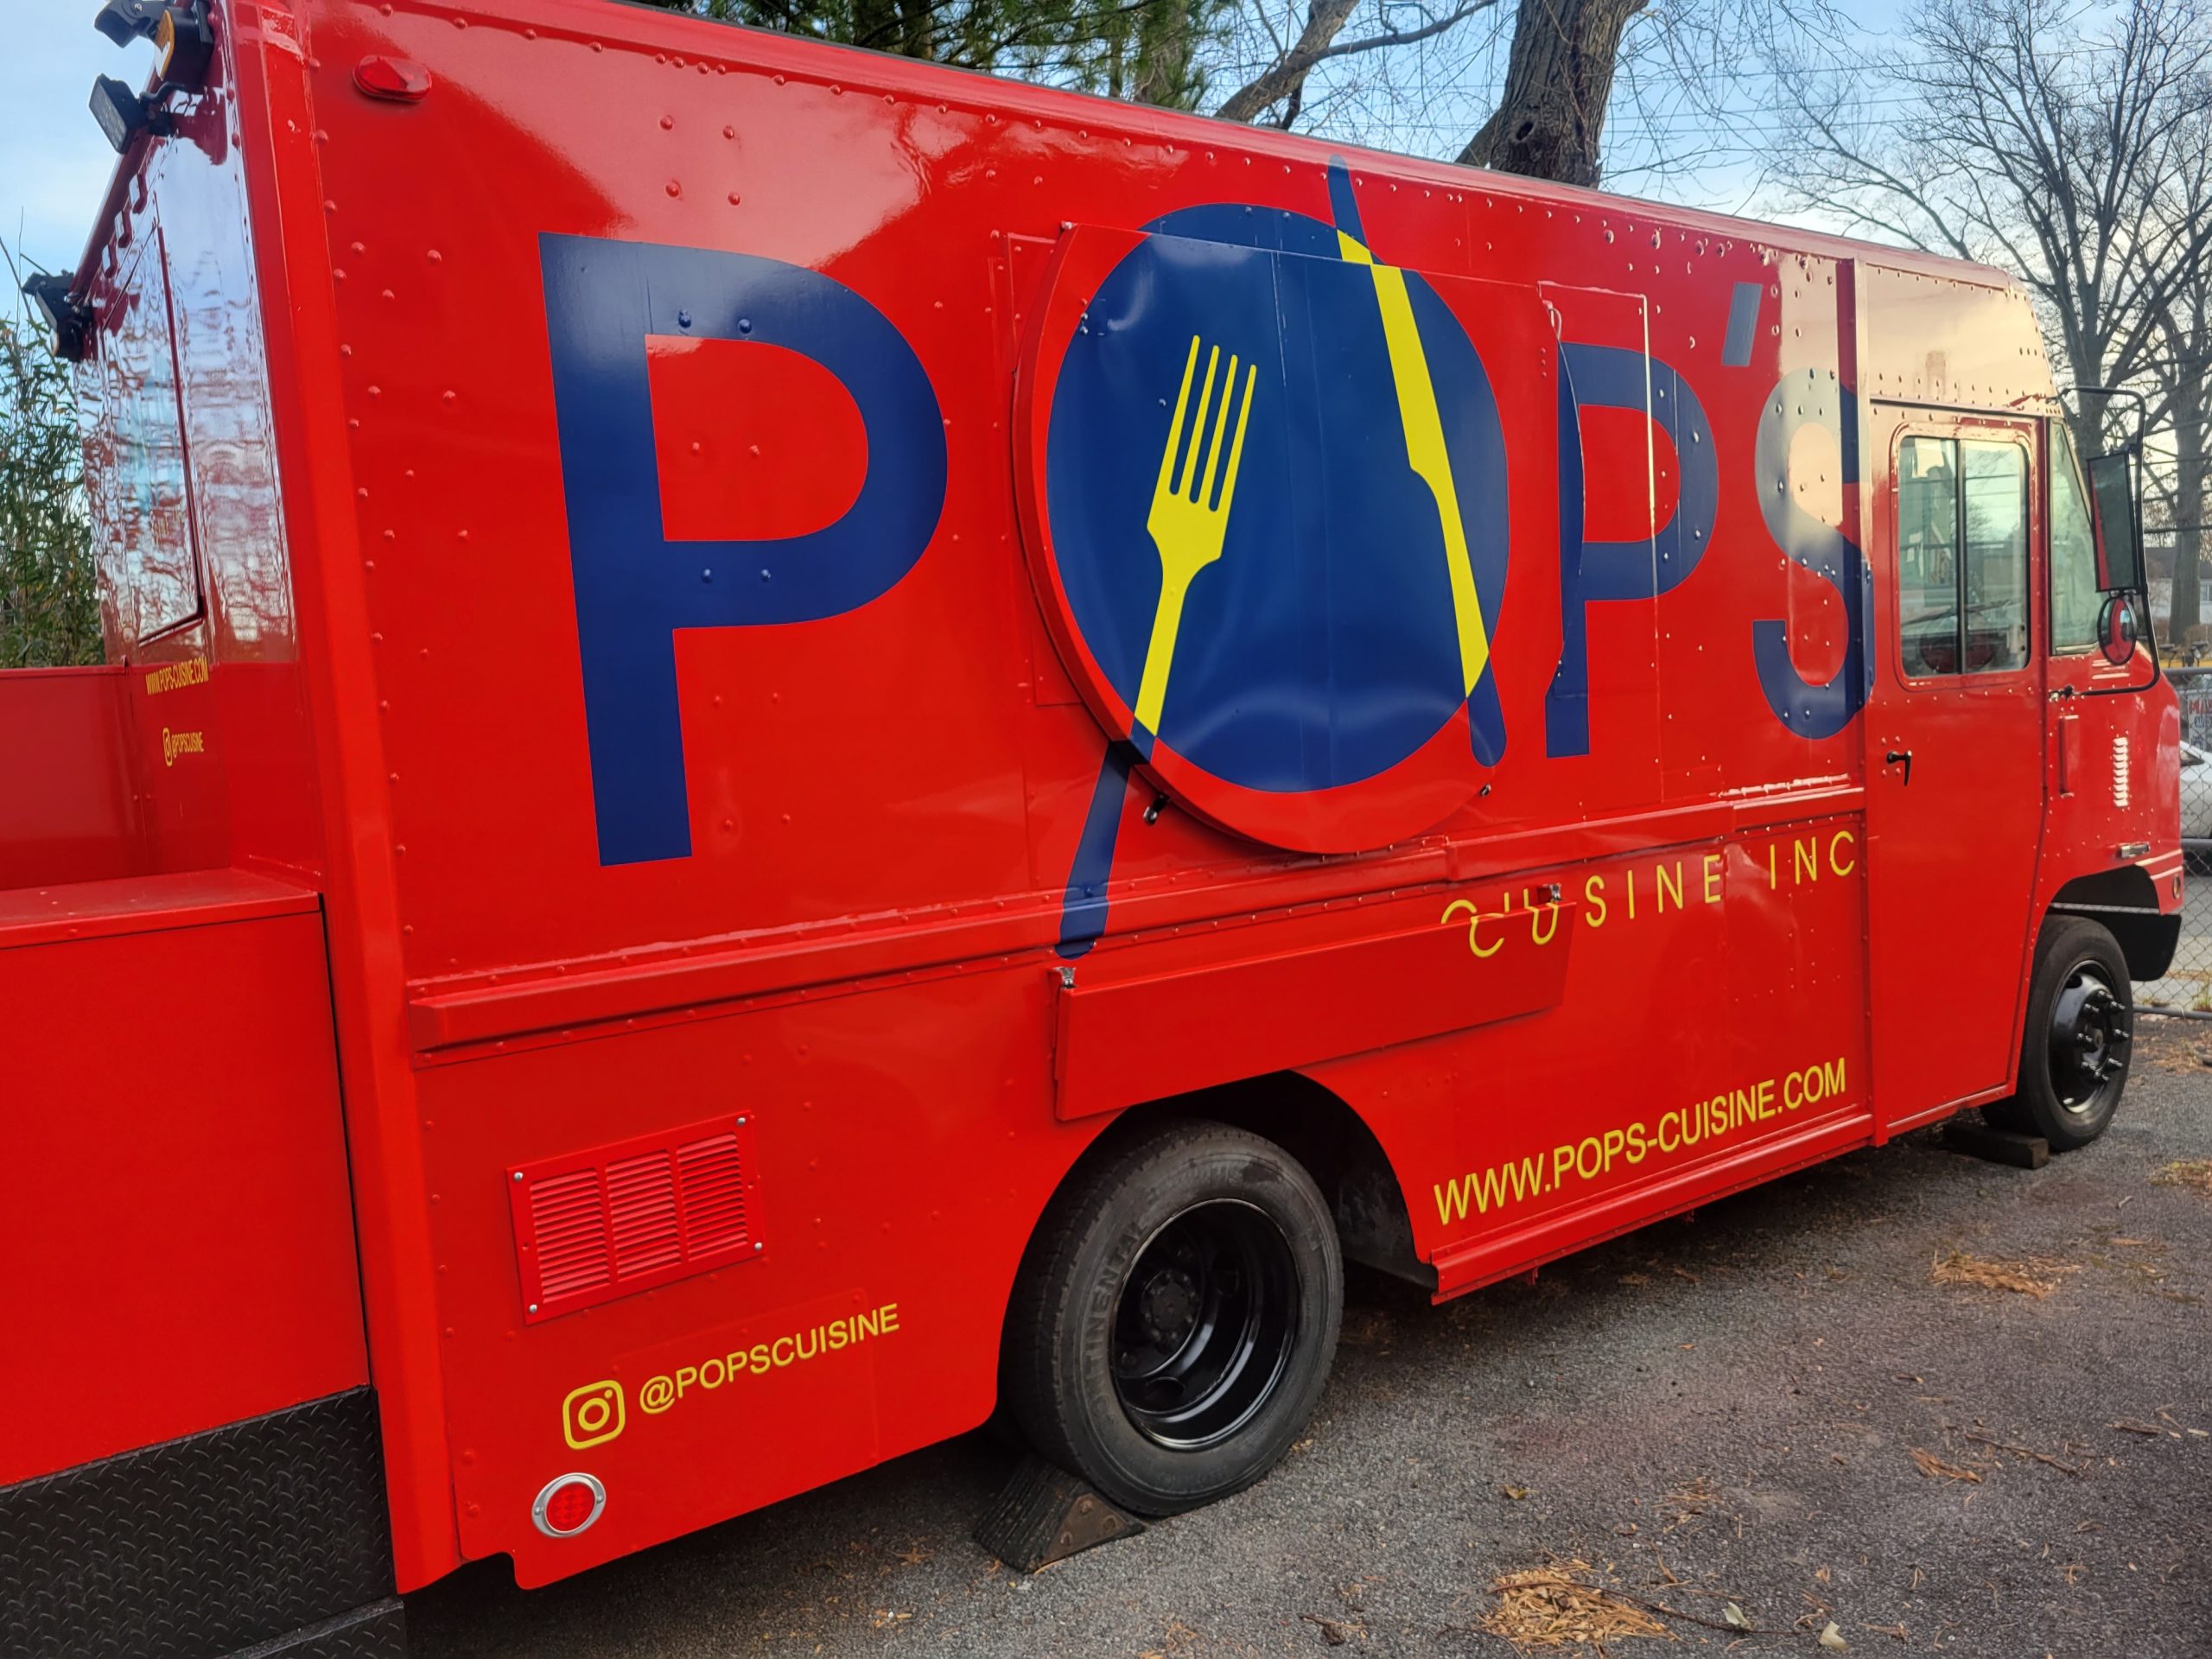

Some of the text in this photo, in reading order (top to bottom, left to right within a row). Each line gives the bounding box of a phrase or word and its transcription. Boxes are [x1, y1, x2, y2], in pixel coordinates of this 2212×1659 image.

[540, 202, 1872, 865] POP'S
[1441, 831, 1854, 957] CUSINE INC
[1434, 1058, 1847, 1225] WWW.POPS-CUISINE.COM
[639, 1303, 899, 1414] @POPSCUISINE
